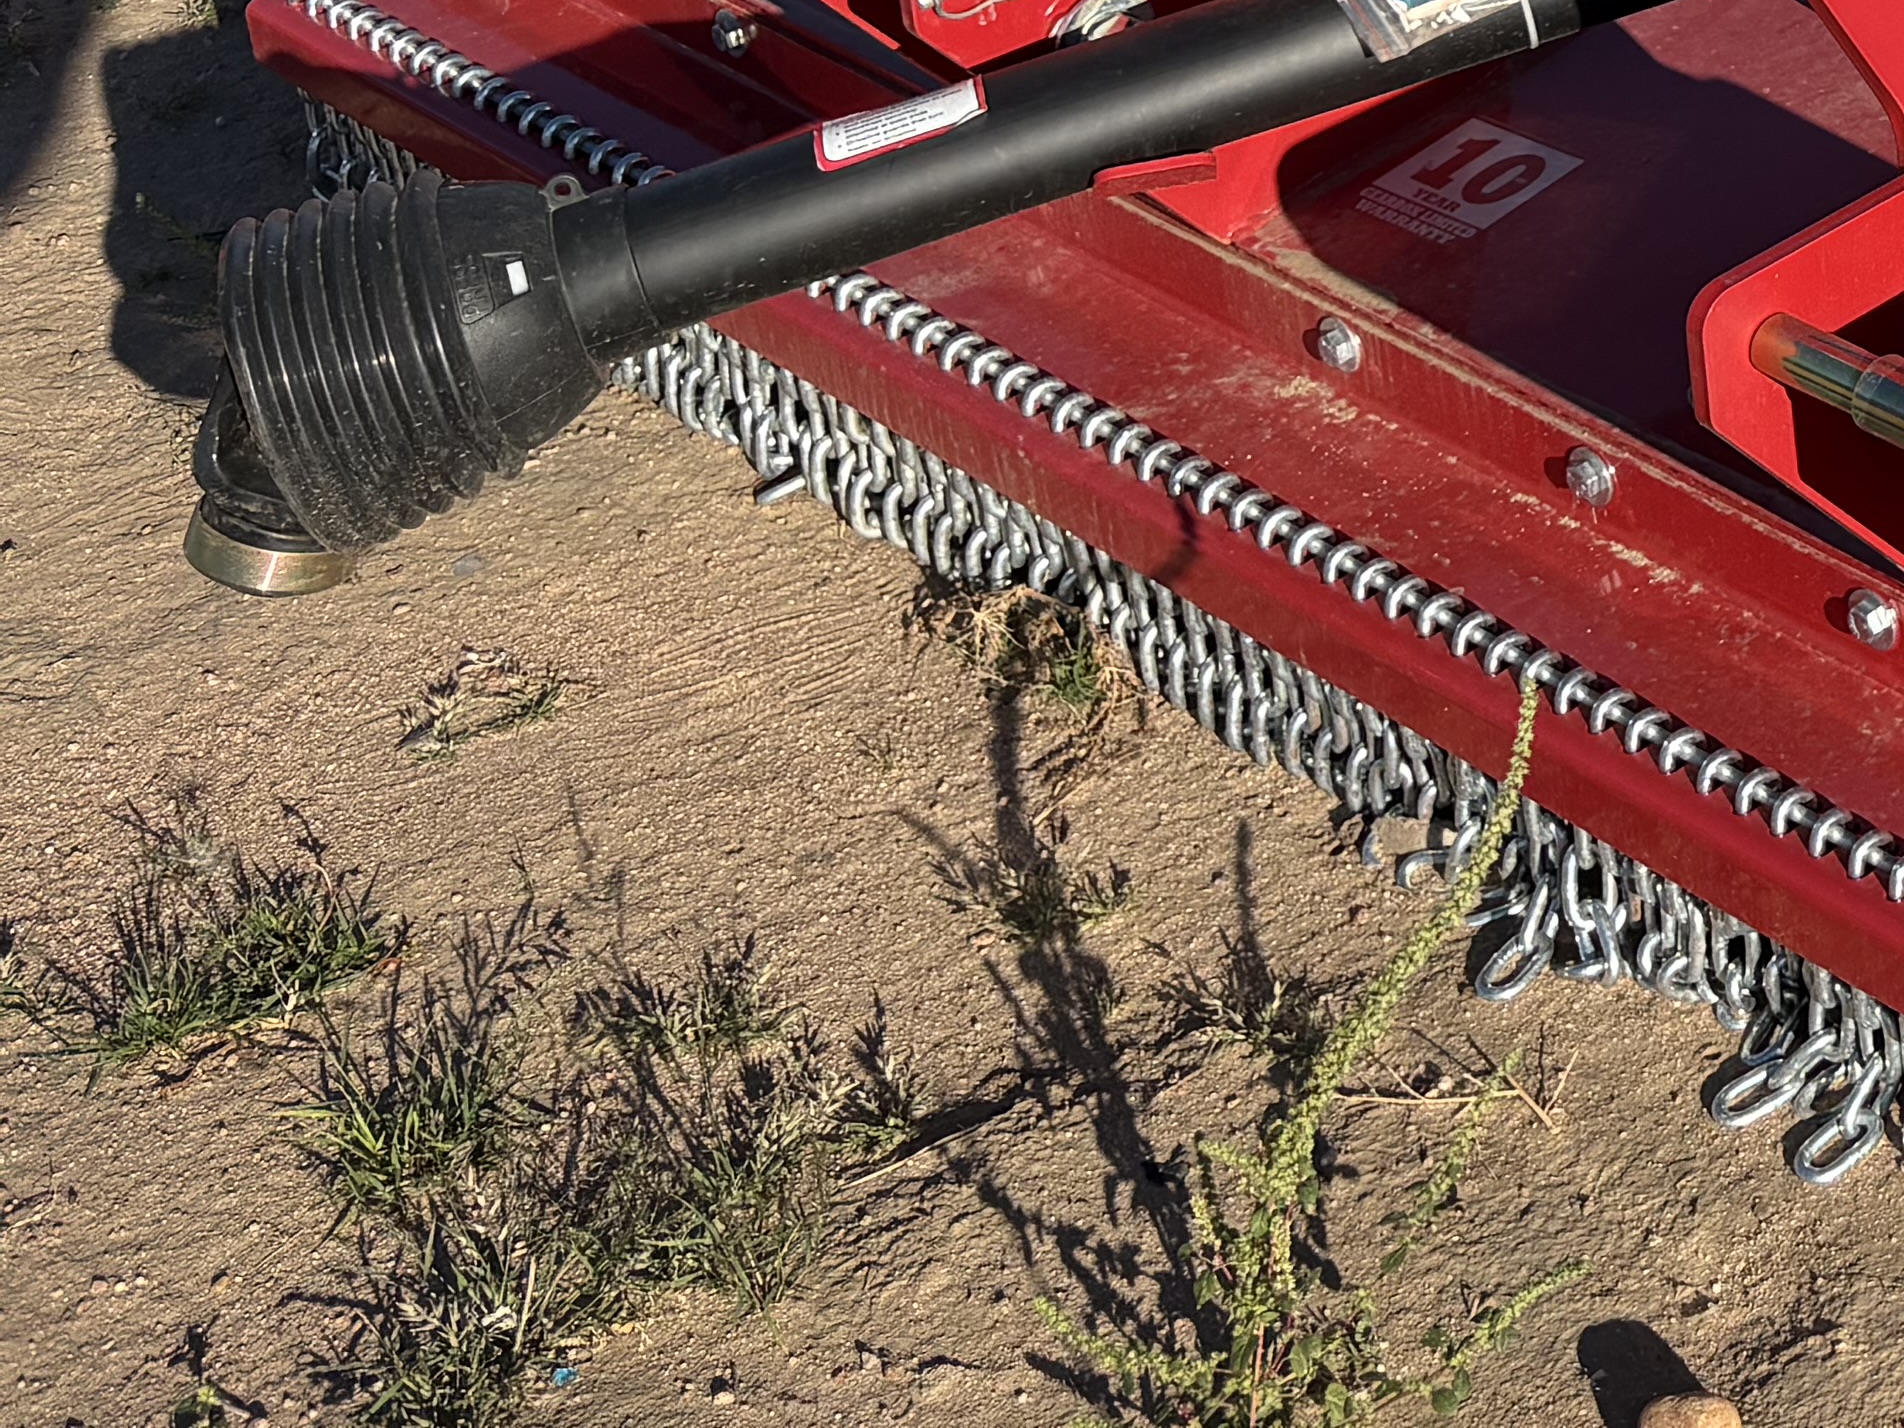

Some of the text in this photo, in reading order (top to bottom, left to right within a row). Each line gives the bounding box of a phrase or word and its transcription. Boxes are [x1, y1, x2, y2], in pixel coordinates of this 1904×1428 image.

[1410, 138, 1546, 204] 10
[1411, 187, 1461, 213] YEAR
[1355, 199, 1455, 244] WARRANTY
[1420, 210, 1478, 238] LIMITED
